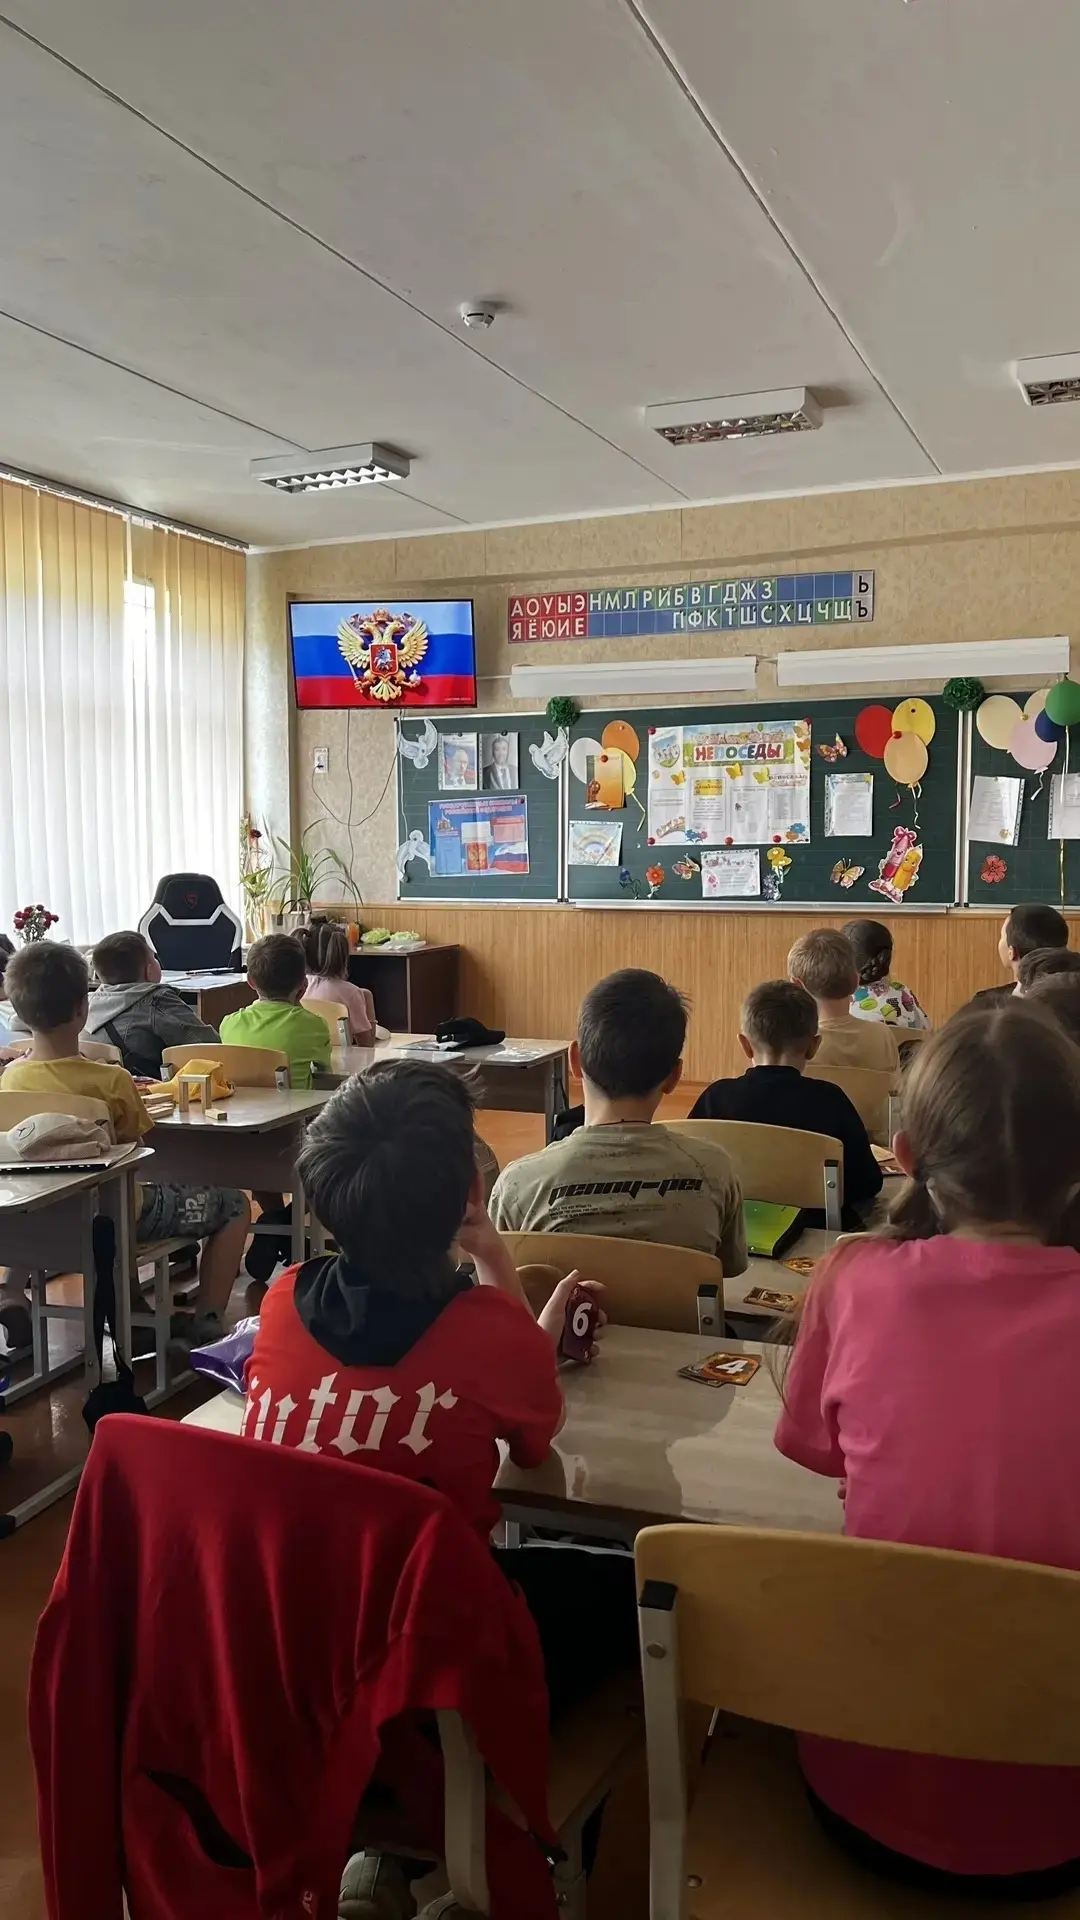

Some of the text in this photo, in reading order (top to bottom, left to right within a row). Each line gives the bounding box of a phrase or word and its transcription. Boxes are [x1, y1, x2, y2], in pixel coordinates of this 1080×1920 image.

[695, 743, 782, 761] НЕПОСЕДЫ
[572, 1302, 593, 1337] 6
[716, 1359, 749, 1375] 4
